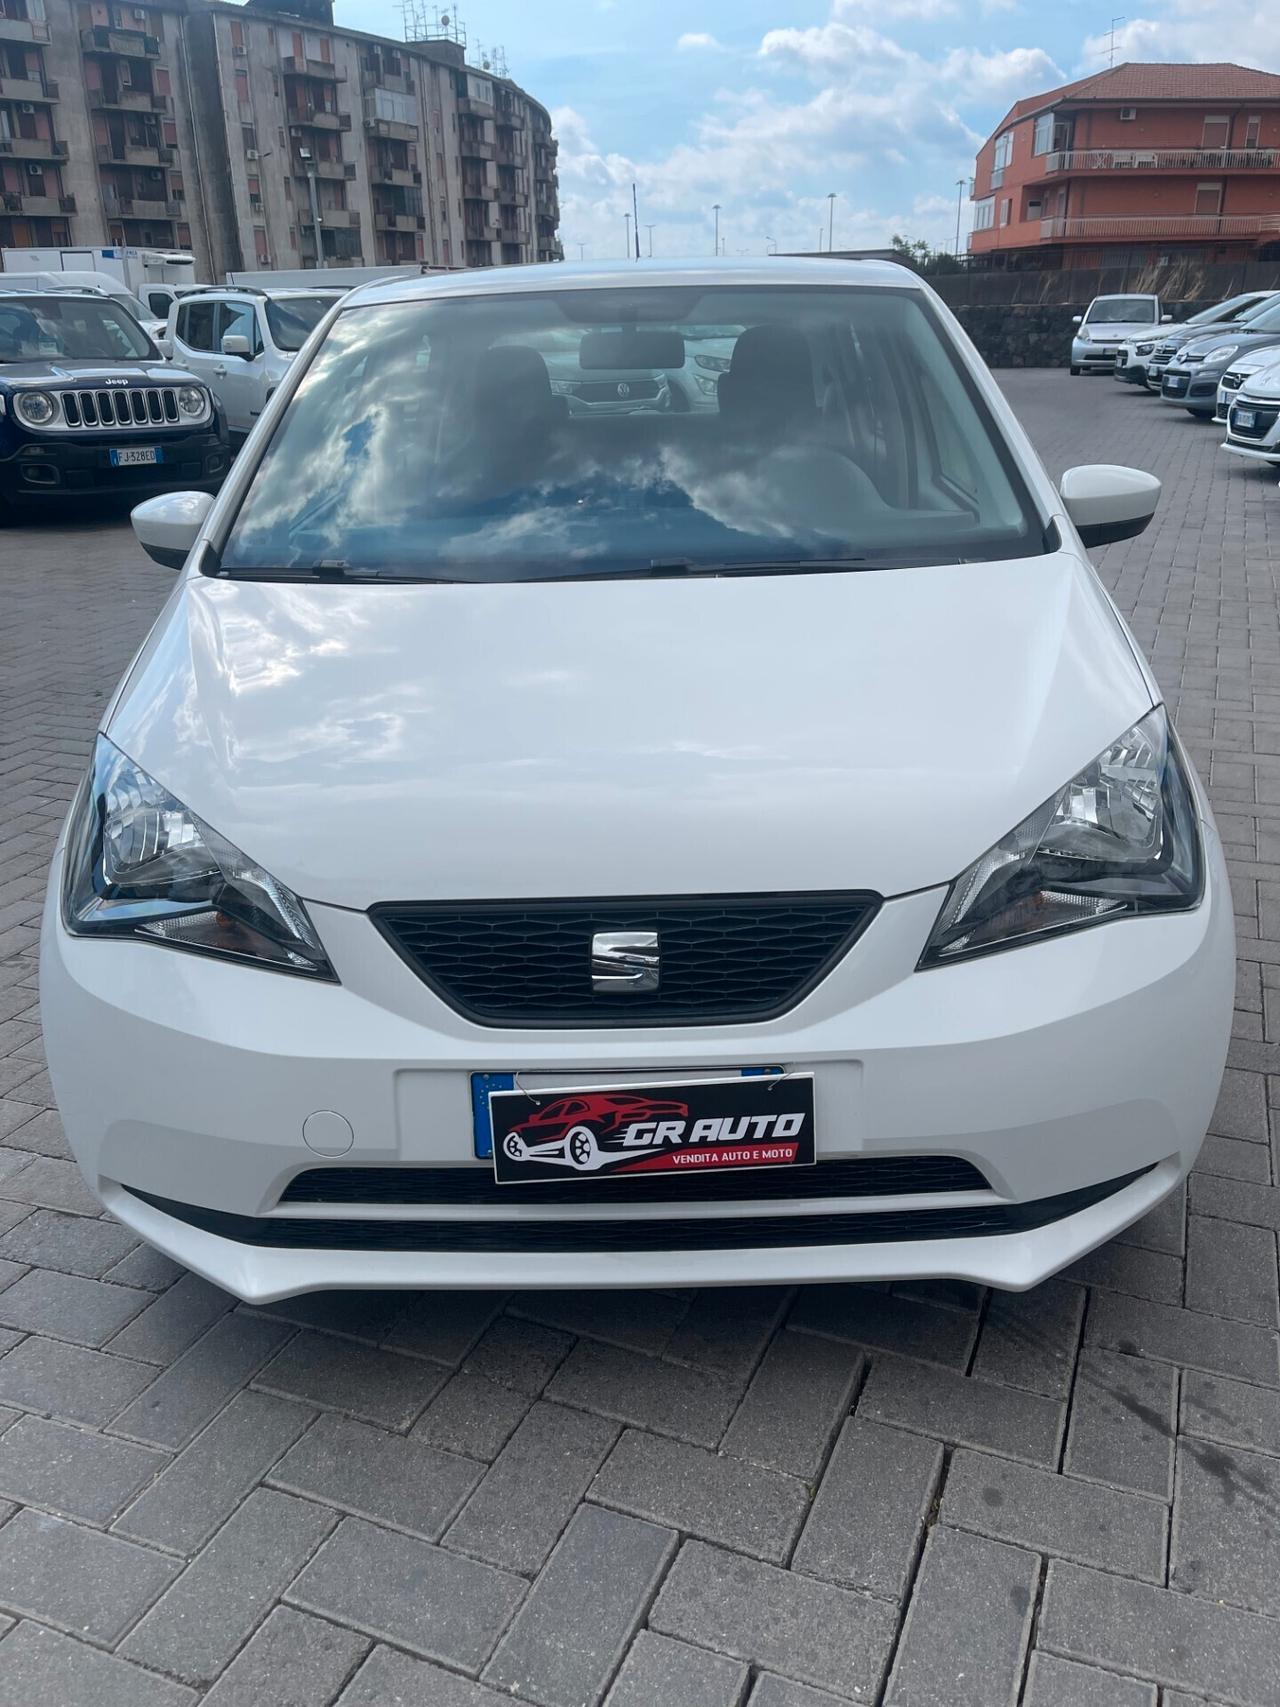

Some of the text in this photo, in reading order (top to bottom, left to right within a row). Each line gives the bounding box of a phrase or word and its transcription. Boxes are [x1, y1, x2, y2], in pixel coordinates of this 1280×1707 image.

[623, 1113, 806, 1147] GR AUTO
[673, 1148, 793, 1164] VENDITA AUTO E MOTO
